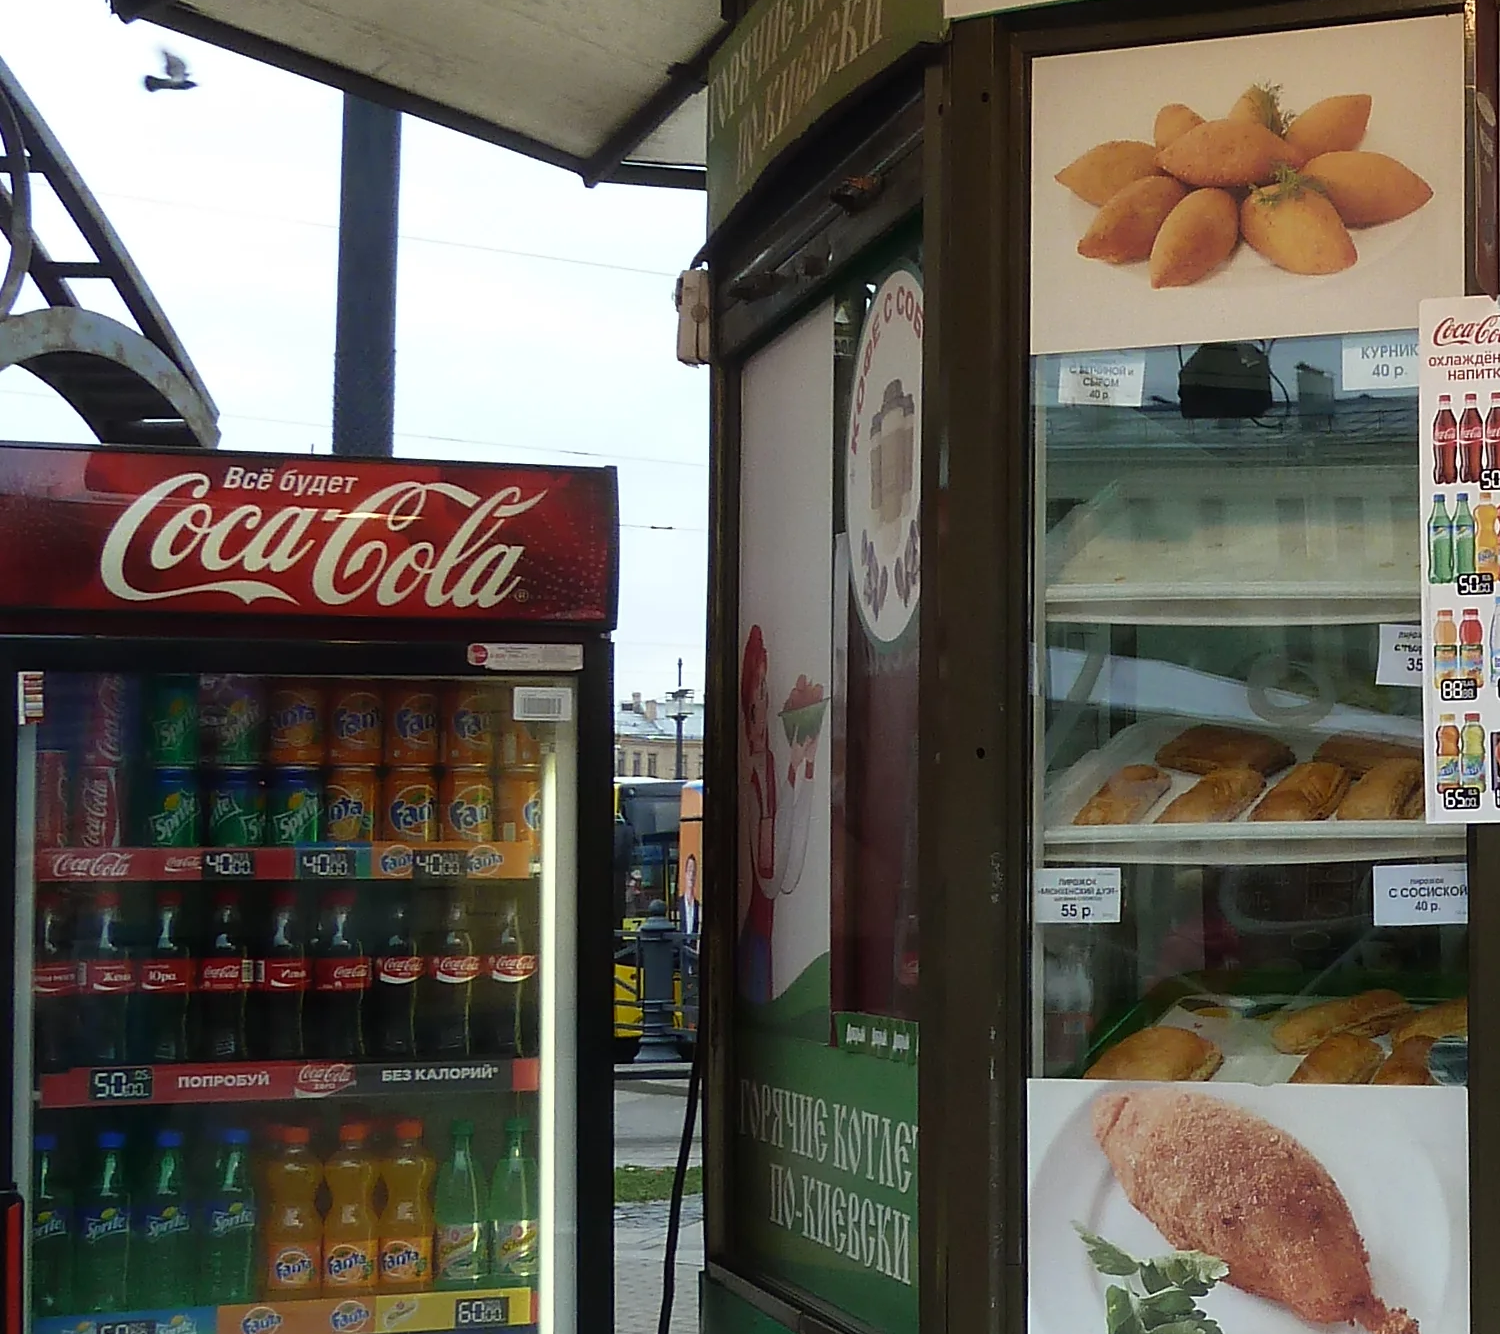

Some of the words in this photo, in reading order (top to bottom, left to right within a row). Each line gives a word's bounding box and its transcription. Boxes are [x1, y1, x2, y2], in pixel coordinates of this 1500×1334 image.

[1372, 364, 1389, 377] 40
[223, 466, 275, 490] Всё
[279, 468, 359, 496] будет
[100, 472, 548, 608] Coca-Cola
[1389, 888, 1397, 898] С
[1400, 884, 1468, 898] СОСИСКОЙ
[1061, 904, 1077, 917] 55
[1414, 901, 1428, 911] 40
[178, 1071, 269, 1088] ПОПРОБУЙ
[382, 1069, 411, 1082] БЕЗ
[740, 1079, 828, 1163] ГОРЯЧИЕ
[770, 1164, 911, 1285] ПО-КИЕВСКИ
